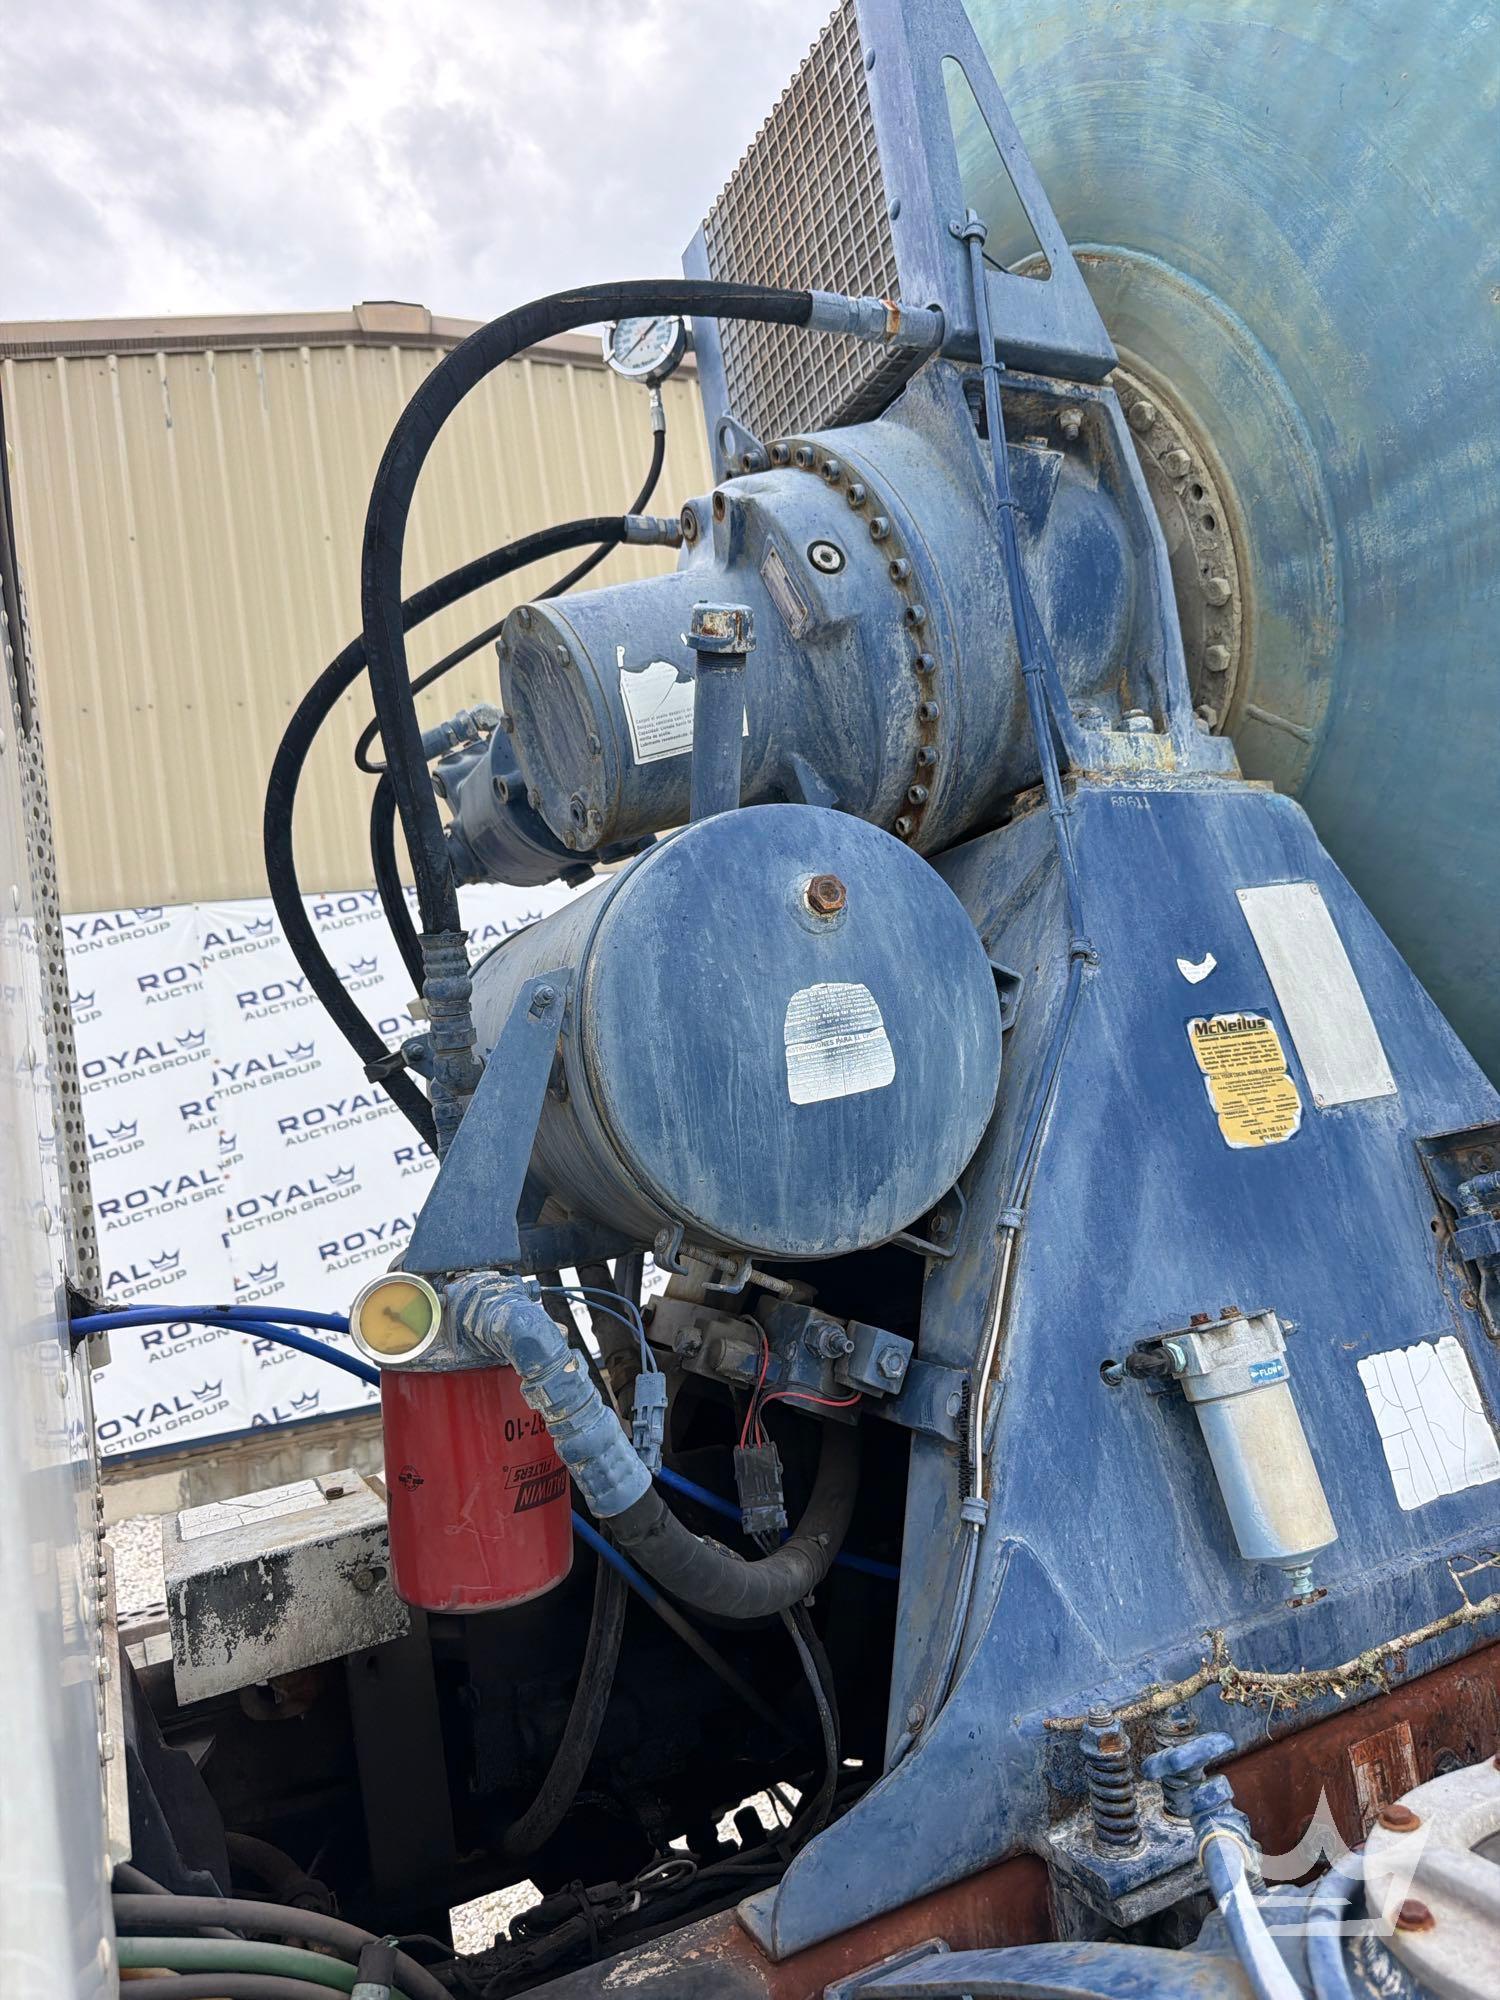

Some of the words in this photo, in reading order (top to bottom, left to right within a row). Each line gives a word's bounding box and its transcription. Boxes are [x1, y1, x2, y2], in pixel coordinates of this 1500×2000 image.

[313, 889, 380, 921] ROY
[320, 909, 382, 933] AUCTIO
[66, 913, 136, 940] YAL
[107, 921, 171, 946] GROUP
[219, 936, 280, 960] GROUP
[236, 976, 306, 1009] ROY
[1194, 1018, 1267, 1035] McNeilus
[82, 1041, 178, 1079] OYAL
[148, 1048, 211, 1075] GROUP
[212, 1053, 288, 1087] YAL
[214, 1080, 257, 1100] TION
[259, 1060, 322, 1087] GROUP
[277, 1089, 390, 1136] ROYAL
[285, 1115, 363, 1147] AUCTION
[365, 1103, 401, 1122] GRO
[88, 1139, 145, 1164] ROUP
[98, 1169, 220, 1219] ROYAL
[227, 1178, 329, 1222] OYAL
[230, 1206, 297, 1236] UCTION
[300, 1184, 362, 1212] GROUP
[105, 1197, 188, 1232] AUCTION
[326, 1240, 402, 1274] AUCTION
[122, 1269, 188, 1299] GROUP
[236, 1281, 286, 1304] ROUP
[148, 1329, 231, 1363] AUCTION
[1259, 1366, 1278, 1377] FLOW
[97, 1396, 194, 1441] OYAL
[104, 1426, 162, 1455] CTION
[165, 1400, 230, 1431] GROUP
[513, 1459, 553, 1483] FILTERS
